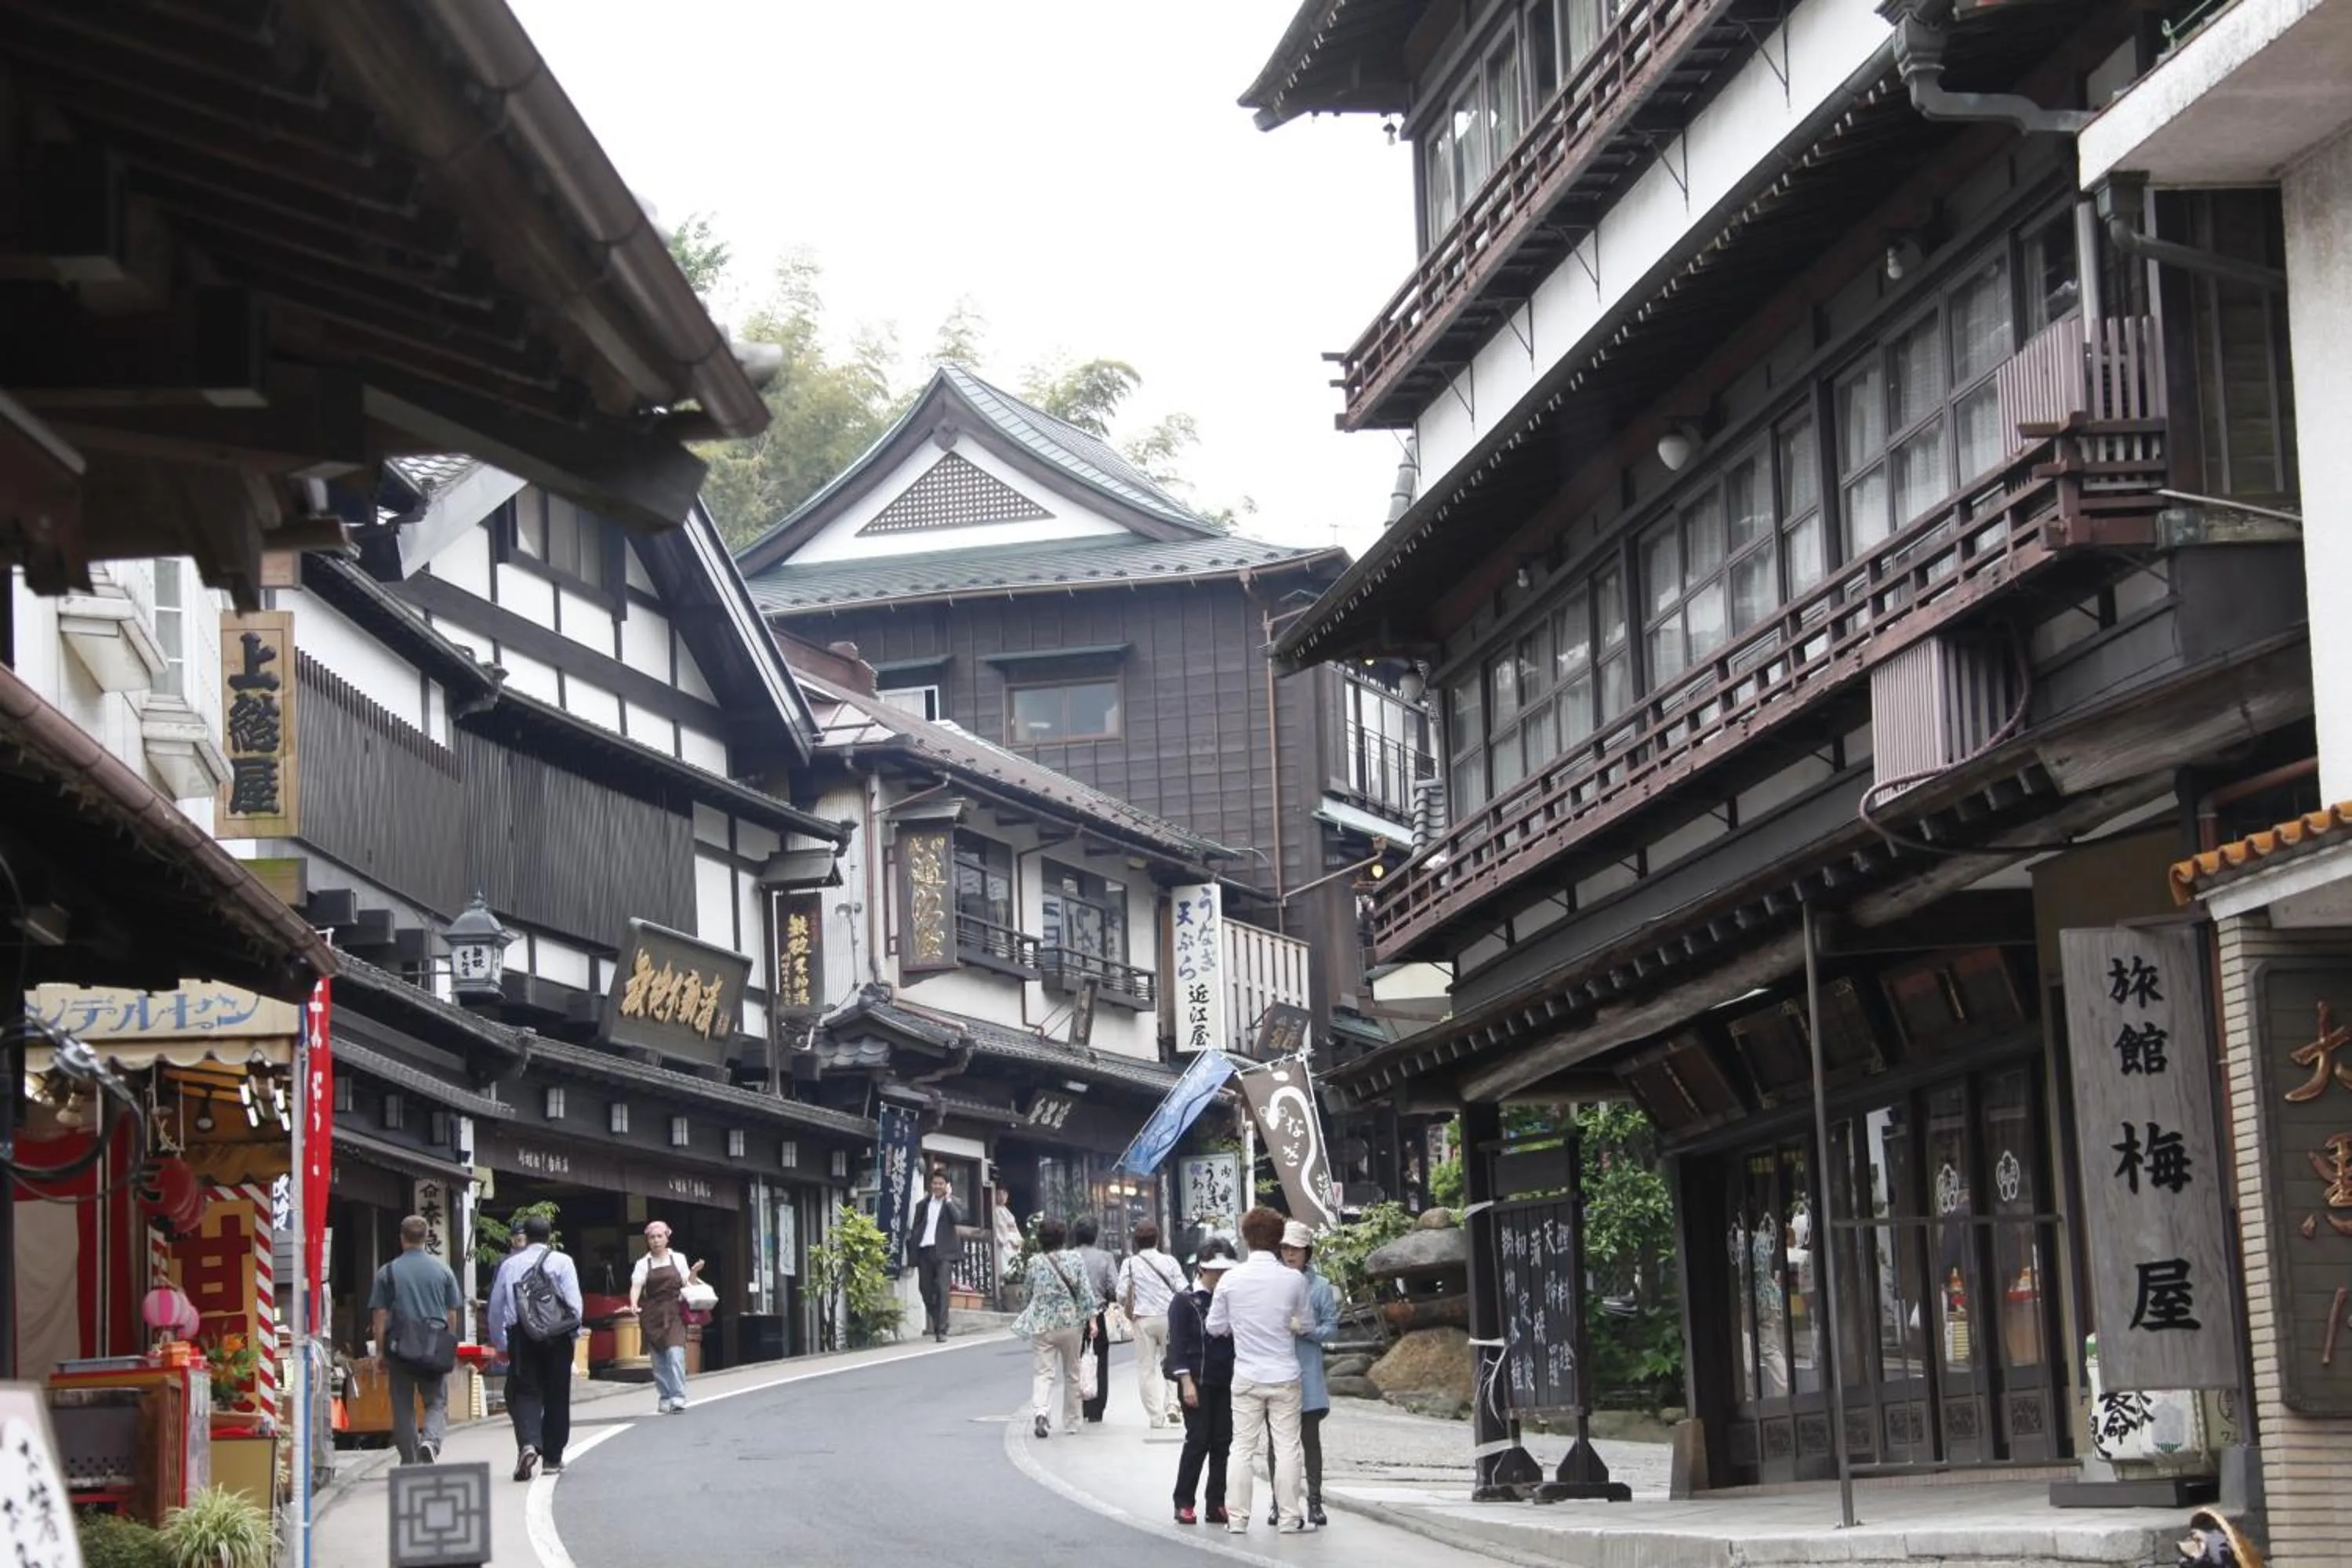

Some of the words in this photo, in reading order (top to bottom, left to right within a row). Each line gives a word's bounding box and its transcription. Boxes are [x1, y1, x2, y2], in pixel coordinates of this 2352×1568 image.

[1198, 887, 1215, 972] うなぎ
[1188, 984, 1210, 1047] 近江屋
[2107, 956, 2201, 1332] 旅館梅屋
